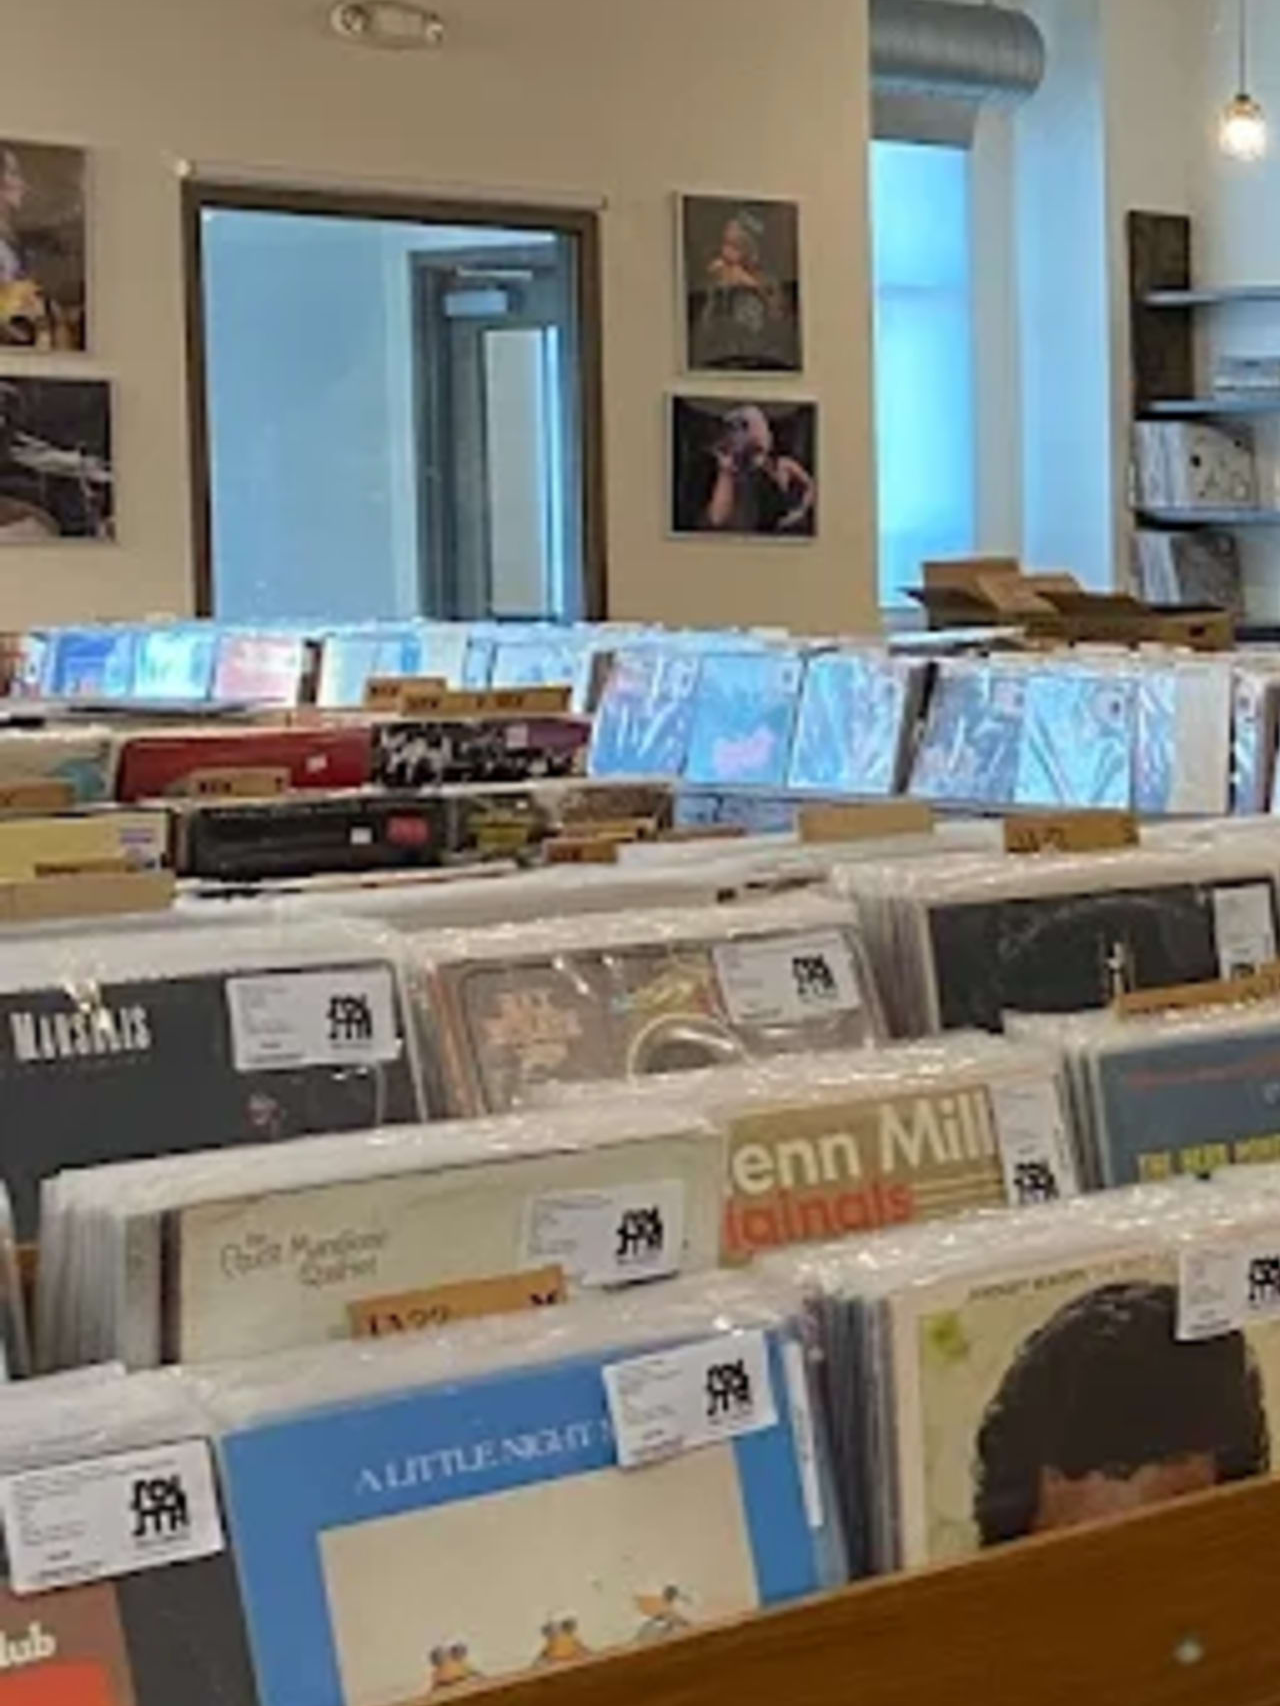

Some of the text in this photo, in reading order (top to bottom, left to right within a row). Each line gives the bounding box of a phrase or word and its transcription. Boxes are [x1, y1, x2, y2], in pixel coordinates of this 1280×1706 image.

[731, 1089, 996, 1194] enn Mill
[726, 1182, 914, 1255] iginals
[385, 1437, 500, 1488] LITTLE
[501, 1419, 594, 1462] NIGHT
[0, 1621, 58, 1668] lub
